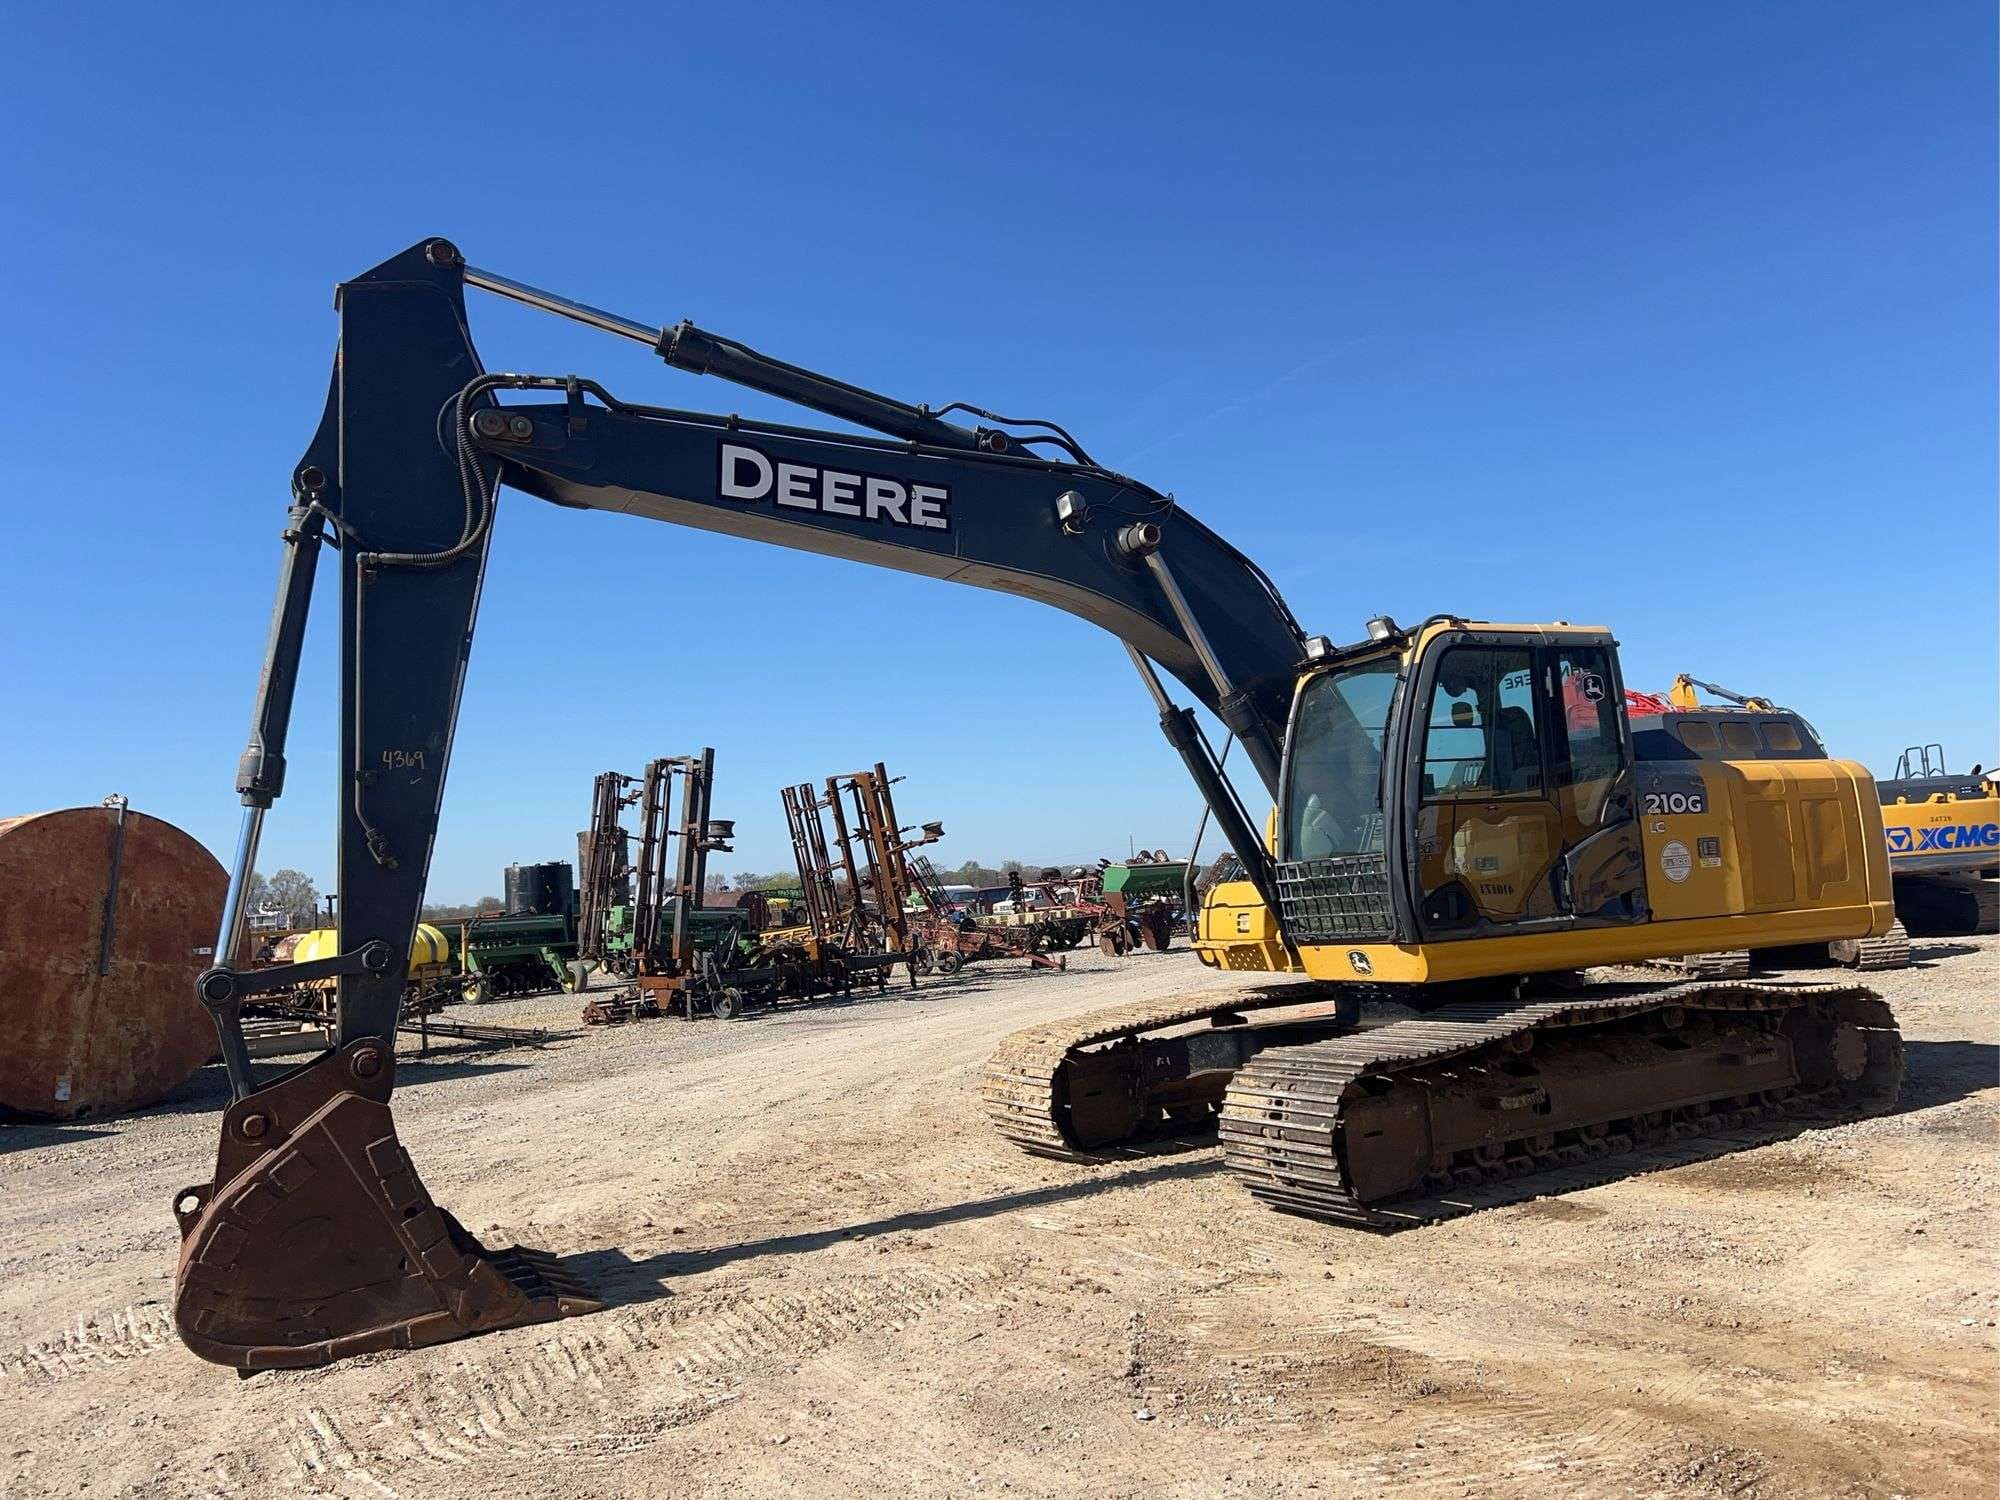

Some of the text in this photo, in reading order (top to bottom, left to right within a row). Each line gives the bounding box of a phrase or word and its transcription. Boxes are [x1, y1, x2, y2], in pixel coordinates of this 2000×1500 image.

[721, 444, 947, 529] DEERE
[382, 750, 425, 770] 4369
[1645, 793, 1702, 814] 210G
[1915, 824, 2000, 851] XCMG
